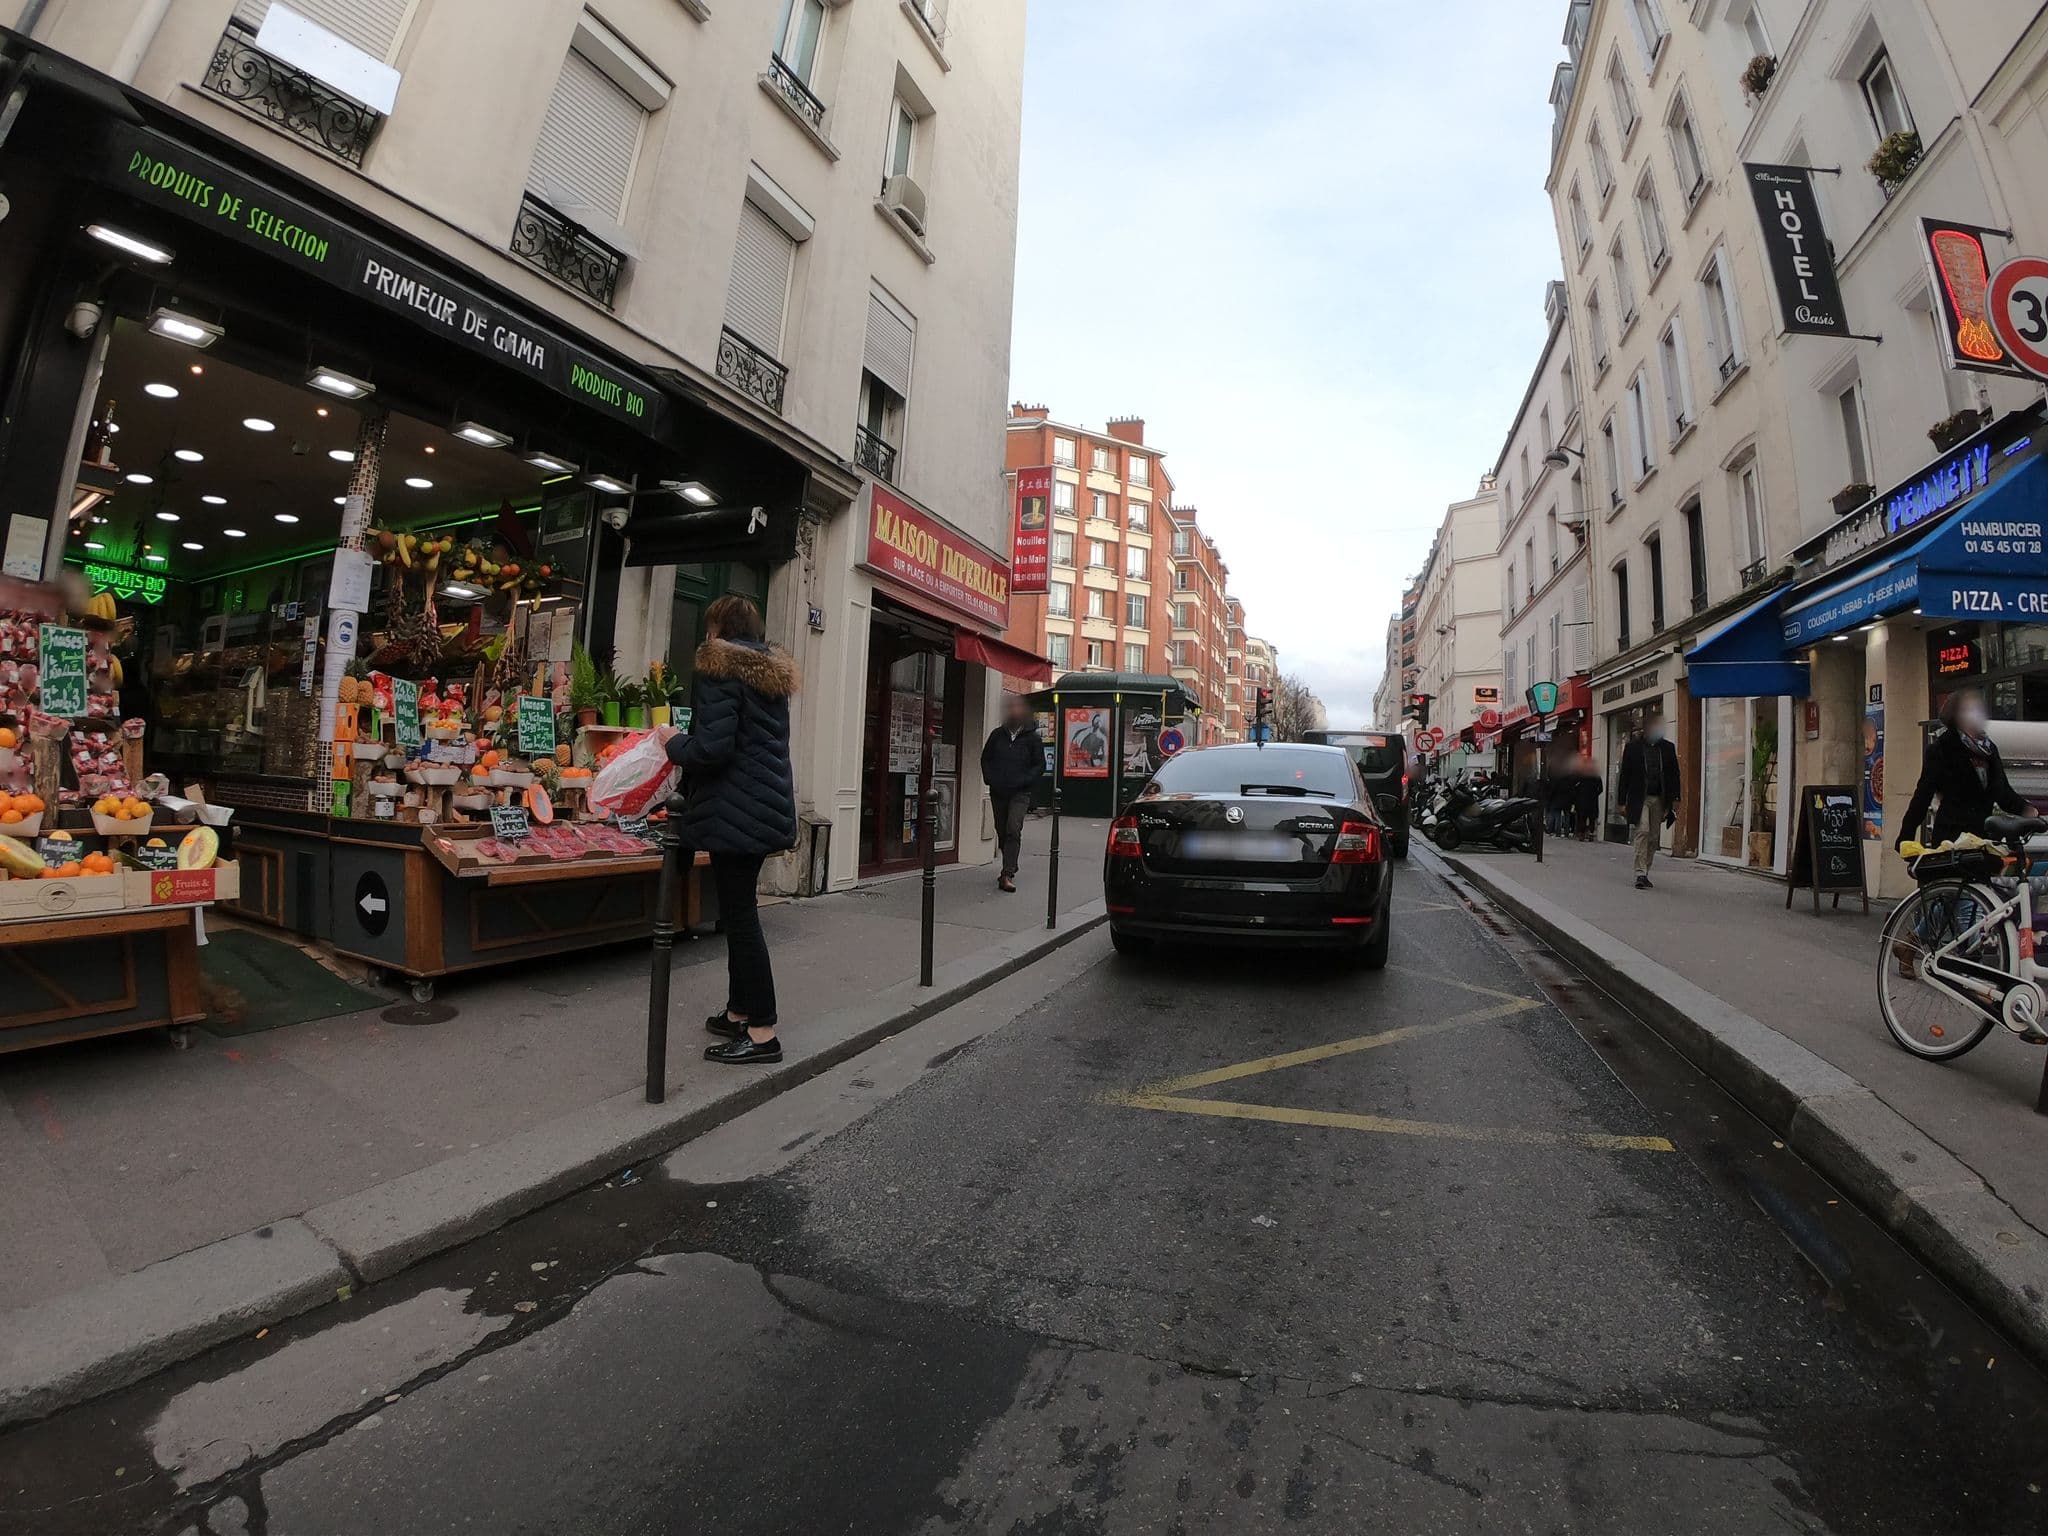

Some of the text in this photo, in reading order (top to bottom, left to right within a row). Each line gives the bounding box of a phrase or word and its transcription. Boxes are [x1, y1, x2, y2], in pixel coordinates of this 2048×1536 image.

[128, 150, 329, 262] PRODUITS DE SELECTION
[1774, 190, 1819, 300] HOTEL
[363, 259, 545, 369] PRIMEUR DE GAMA
[1795, 305, 1835, 325] Oasis
[2012, 290, 2048, 342] 3
[572, 364, 644, 417] PRODUITS BIO
[1961, 522, 2042, 537] HAMBURGER
[1017, 535, 1046, 546] Nouilles
[1965, 541, 2042, 554] 01 45 45 07 28
[875, 504, 1007, 605] MAISON IMPERIALE
[1020, 555, 1027, 564] la
[1028, 554, 1046, 564] Main
[84, 564, 166, 593] PRODUITS BIO
[893, 557, 905, 572] SUR
[907, 563, 925, 583] PLACE
[925, 573, 934, 586] OU
[940, 580, 965, 601] EMPORTER
[1867, 584, 1894, 604] CHEESE
[1894, 574, 1918, 594] NAAN
[1952, 590, 2003, 611] PIZZA
[811, 609, 821, 624] 74
[1940, 645, 1969, 662] PIZZA
[1871, 687, 1881, 701] 81
[1299, 822, 1335, 830] OCTAVIA
[1820, 829, 1852, 845] Boisson
[175, 878, 210, 889] Fruits &
